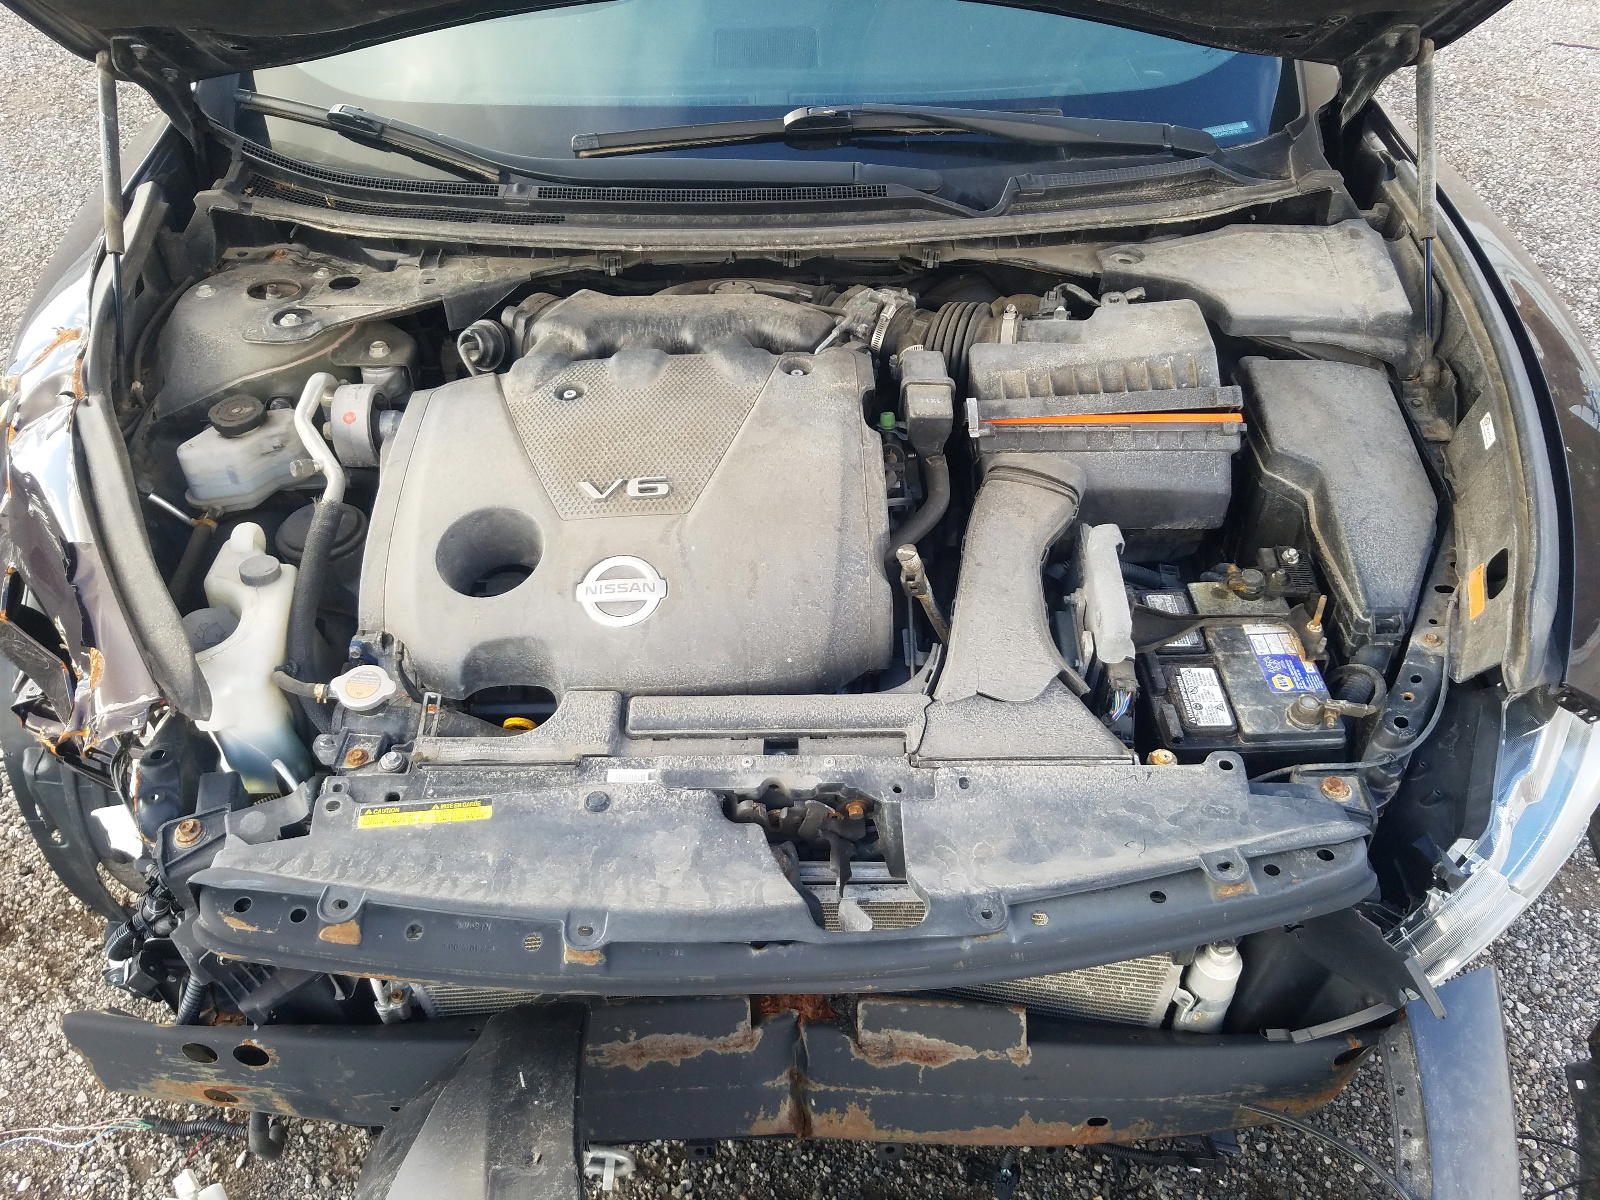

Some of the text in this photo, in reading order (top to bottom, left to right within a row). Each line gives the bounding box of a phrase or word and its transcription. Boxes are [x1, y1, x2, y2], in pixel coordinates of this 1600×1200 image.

[579, 476, 669, 499] V6
[585, 582, 656, 596] NISSAN
[373, 807, 400, 815] CAUTION
